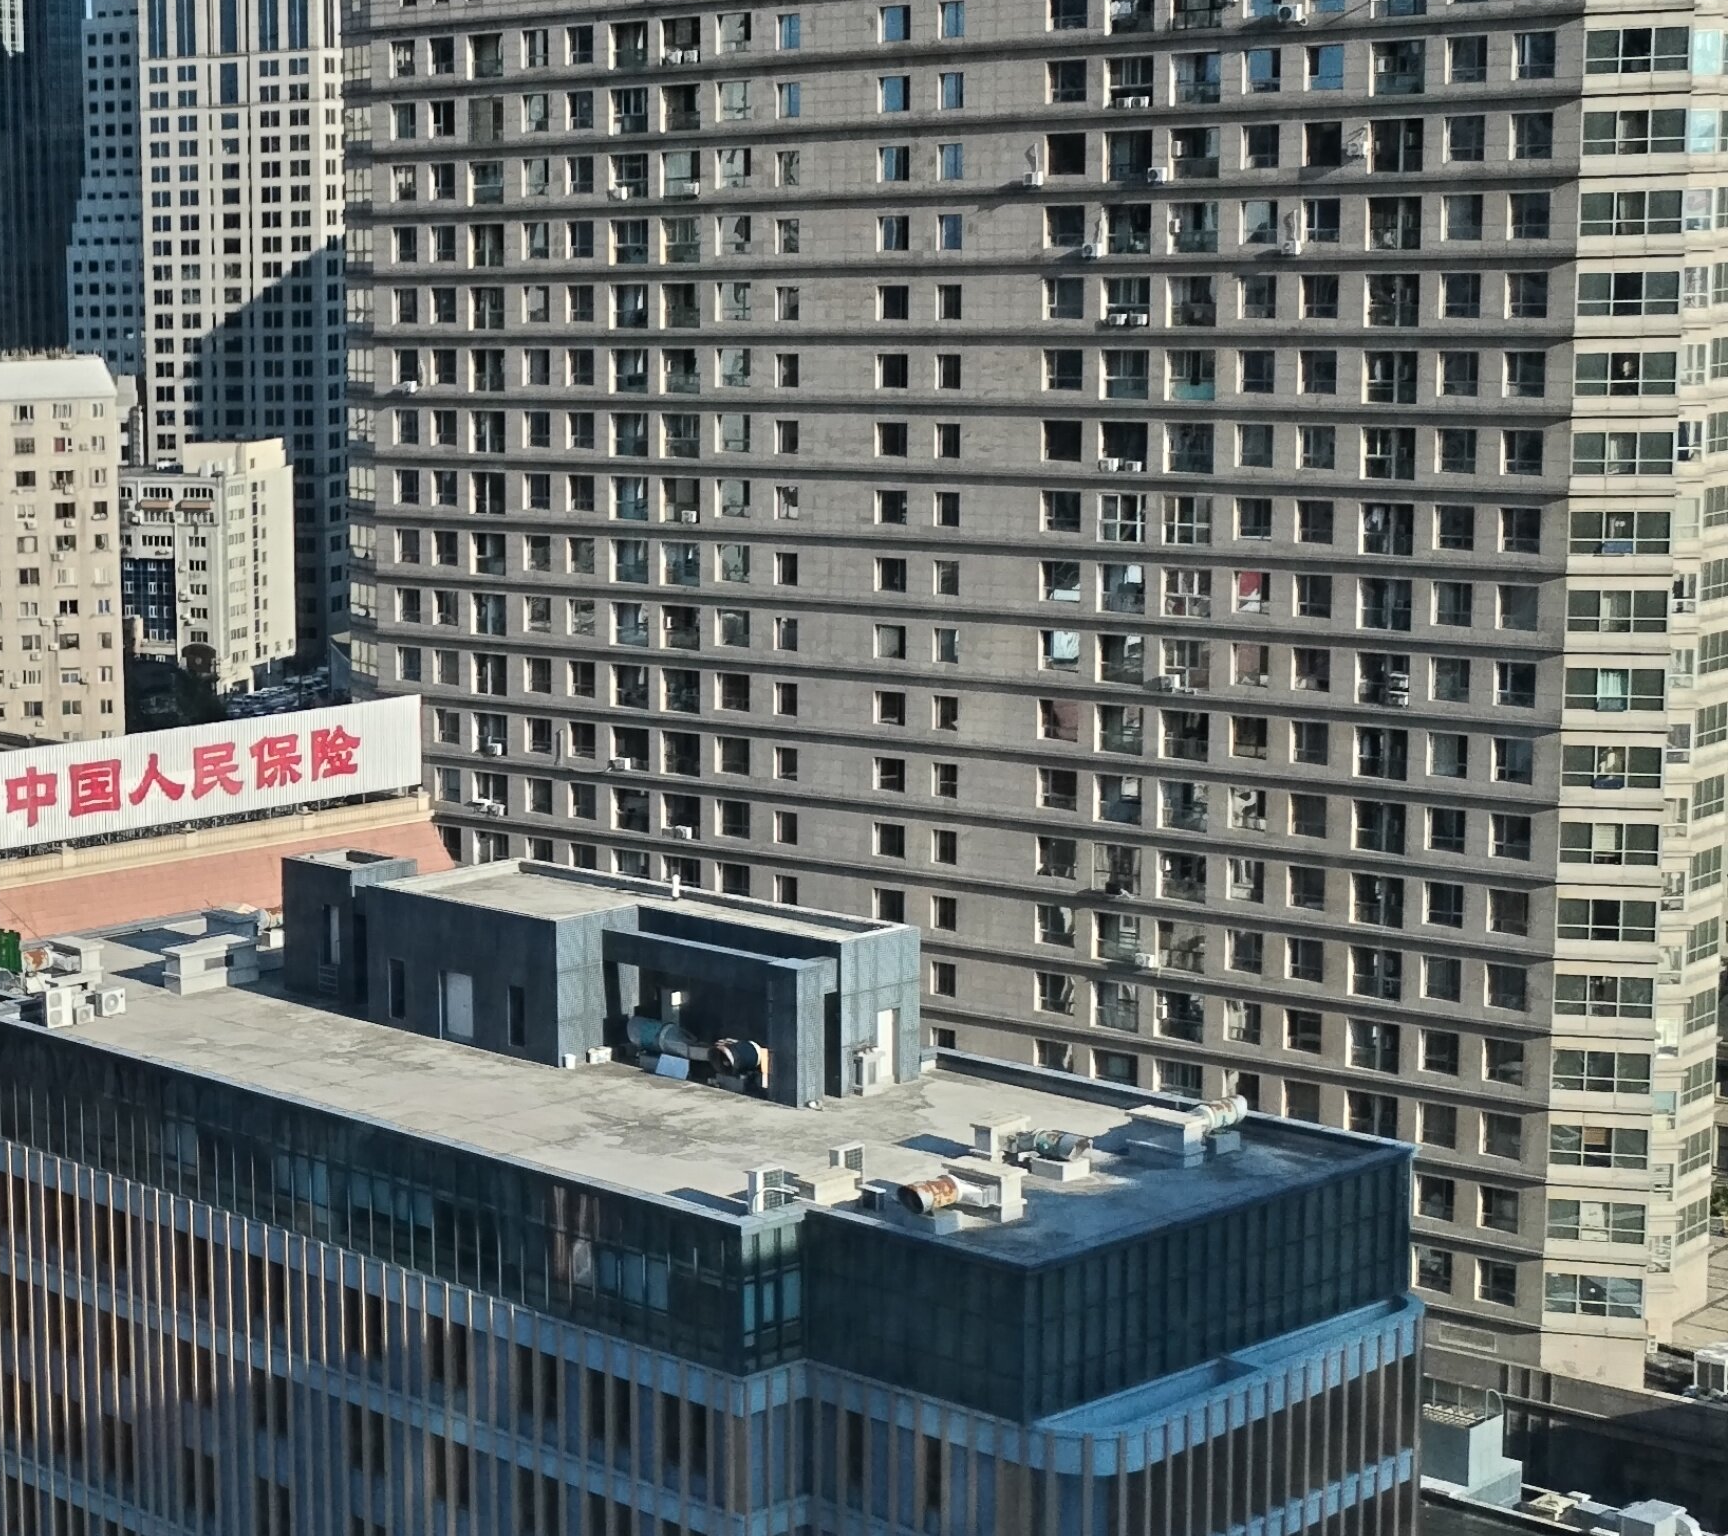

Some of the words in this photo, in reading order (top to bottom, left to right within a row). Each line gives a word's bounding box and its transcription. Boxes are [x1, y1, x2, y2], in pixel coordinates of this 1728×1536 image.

[4, 725, 362, 828] 中国人民保险
